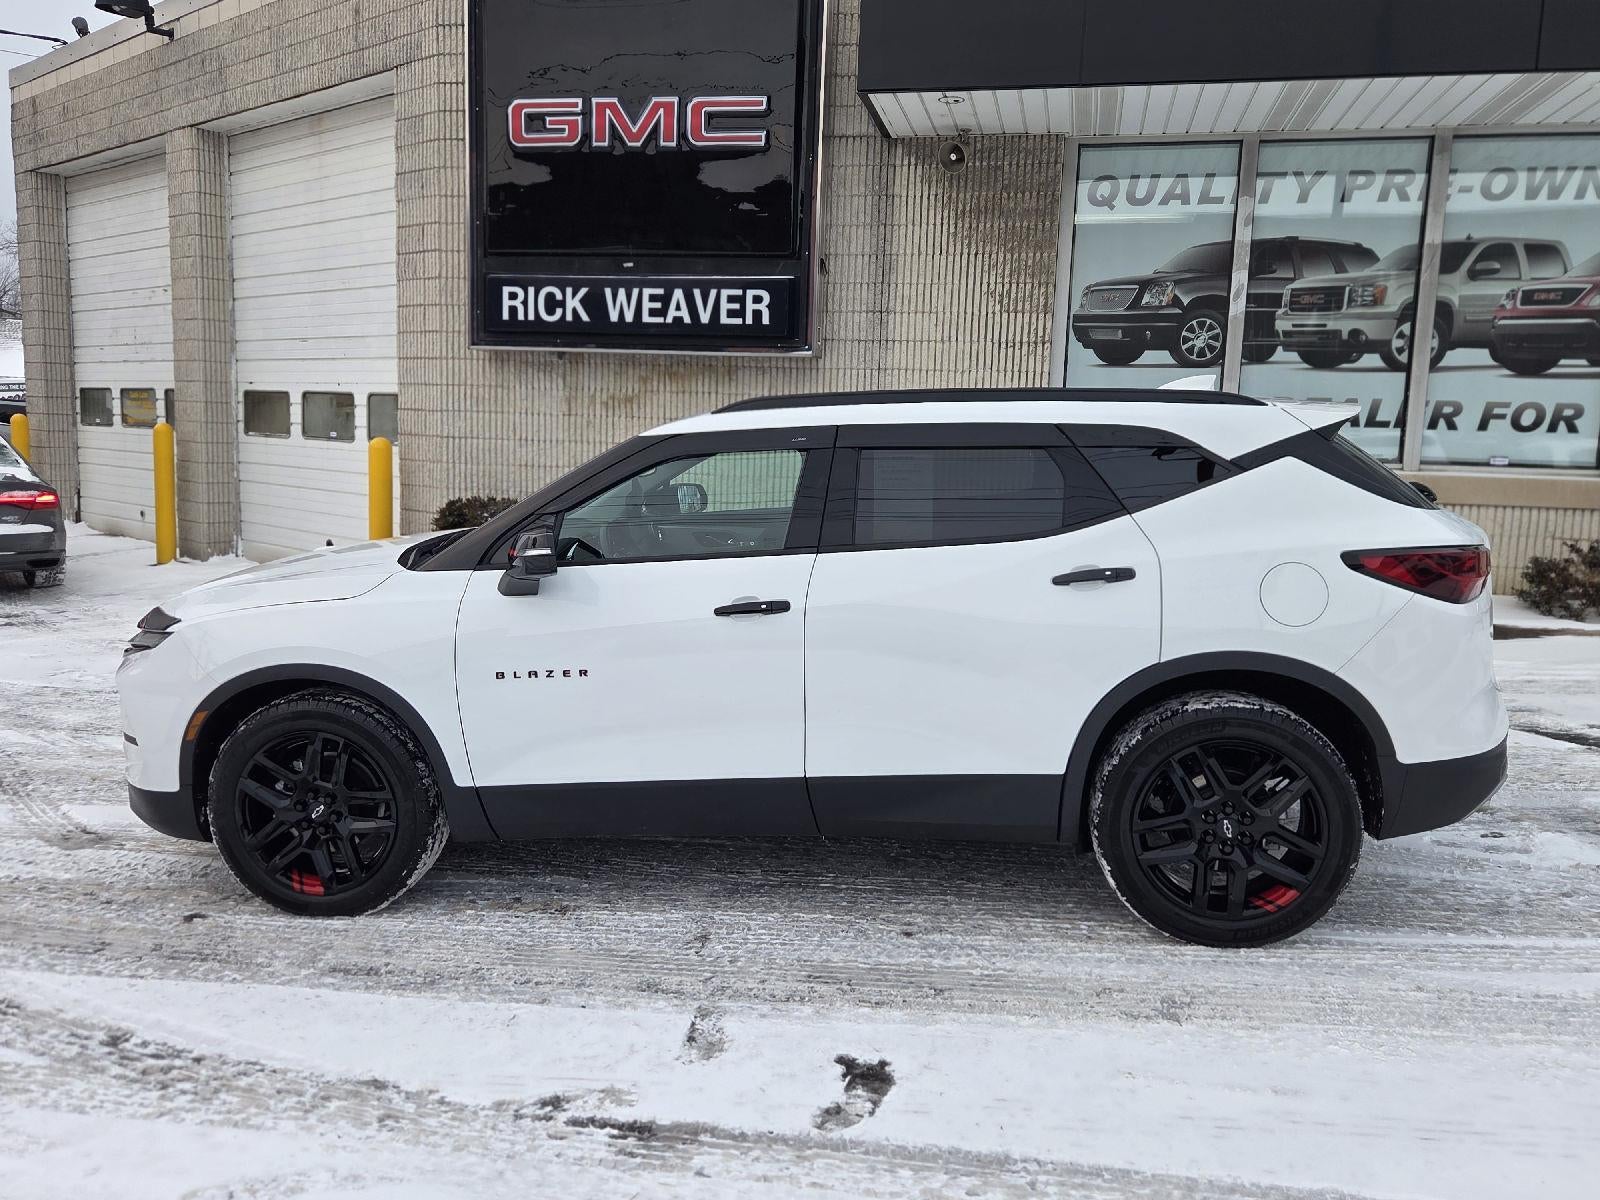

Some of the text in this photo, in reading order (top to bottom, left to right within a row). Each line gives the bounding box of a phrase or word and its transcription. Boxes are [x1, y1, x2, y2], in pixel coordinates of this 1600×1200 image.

[508, 96, 767, 147] GMC
[1087, 170, 1328, 211] QUALTY
[501, 285, 771, 326] RICK WEAVER
[1476, 401, 1585, 434] FOR
[495, 669, 589, 680] BLAZER
